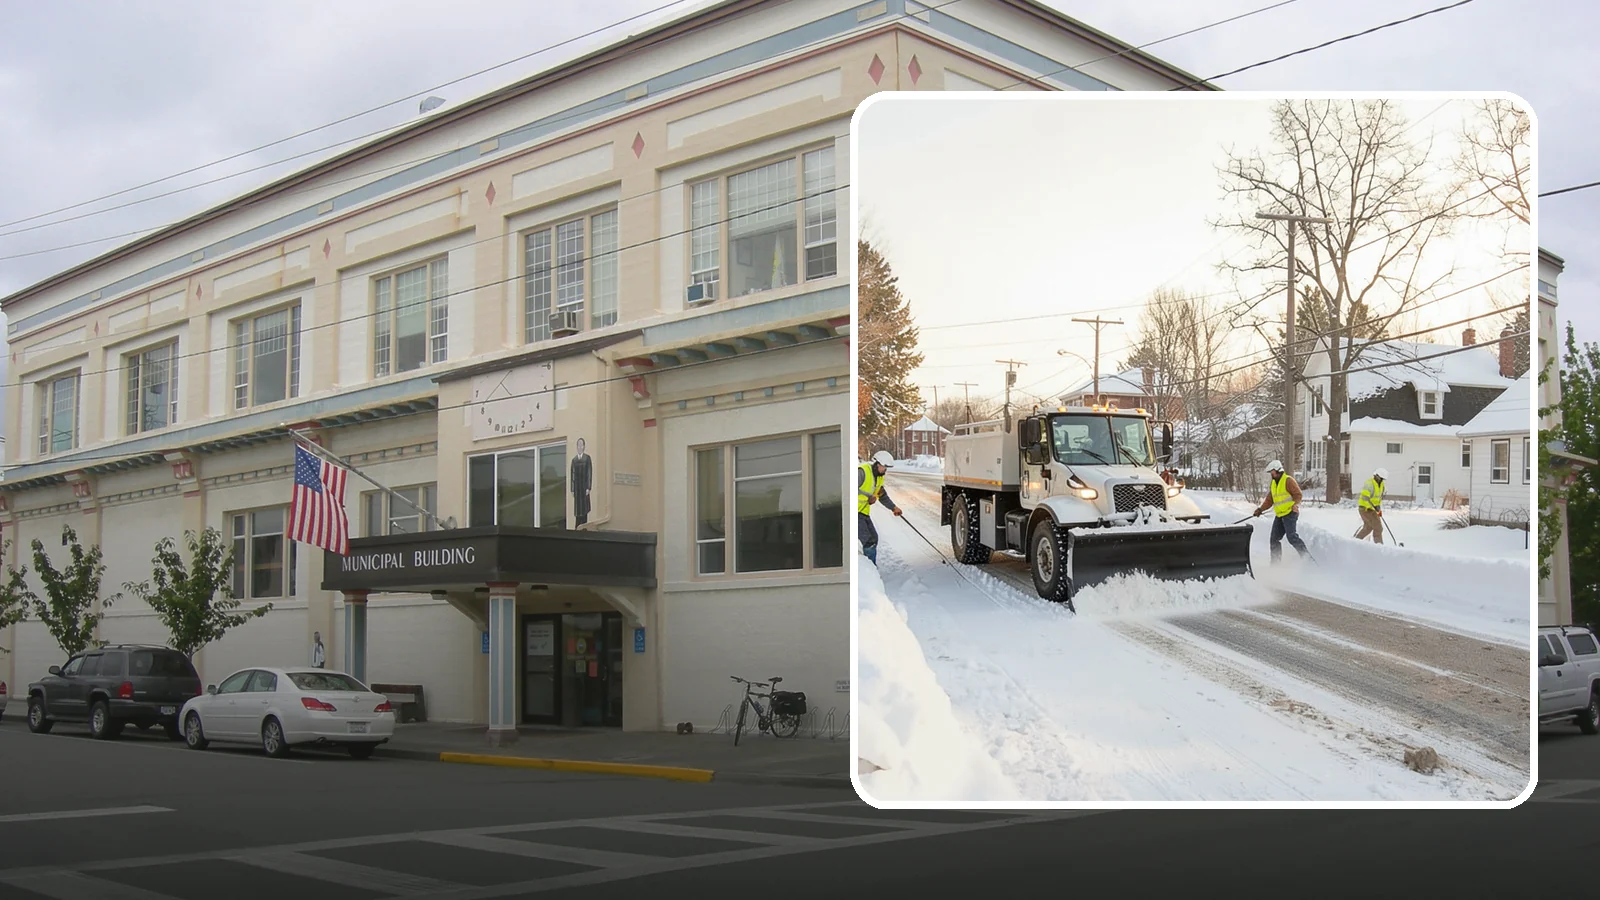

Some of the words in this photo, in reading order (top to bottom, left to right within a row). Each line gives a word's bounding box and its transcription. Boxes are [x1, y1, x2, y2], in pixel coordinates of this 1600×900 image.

[481, 407, 485, 415] 8
[501, 425, 506, 433] 11
[507, 425, 513, 433] 12
[521, 420, 525, 428] 2
[529, 414, 533, 422] 3
[536, 402, 540, 410] 4
[342, 553, 405, 571] MUNICIPAL
[414, 547, 475, 567] BUILDING
